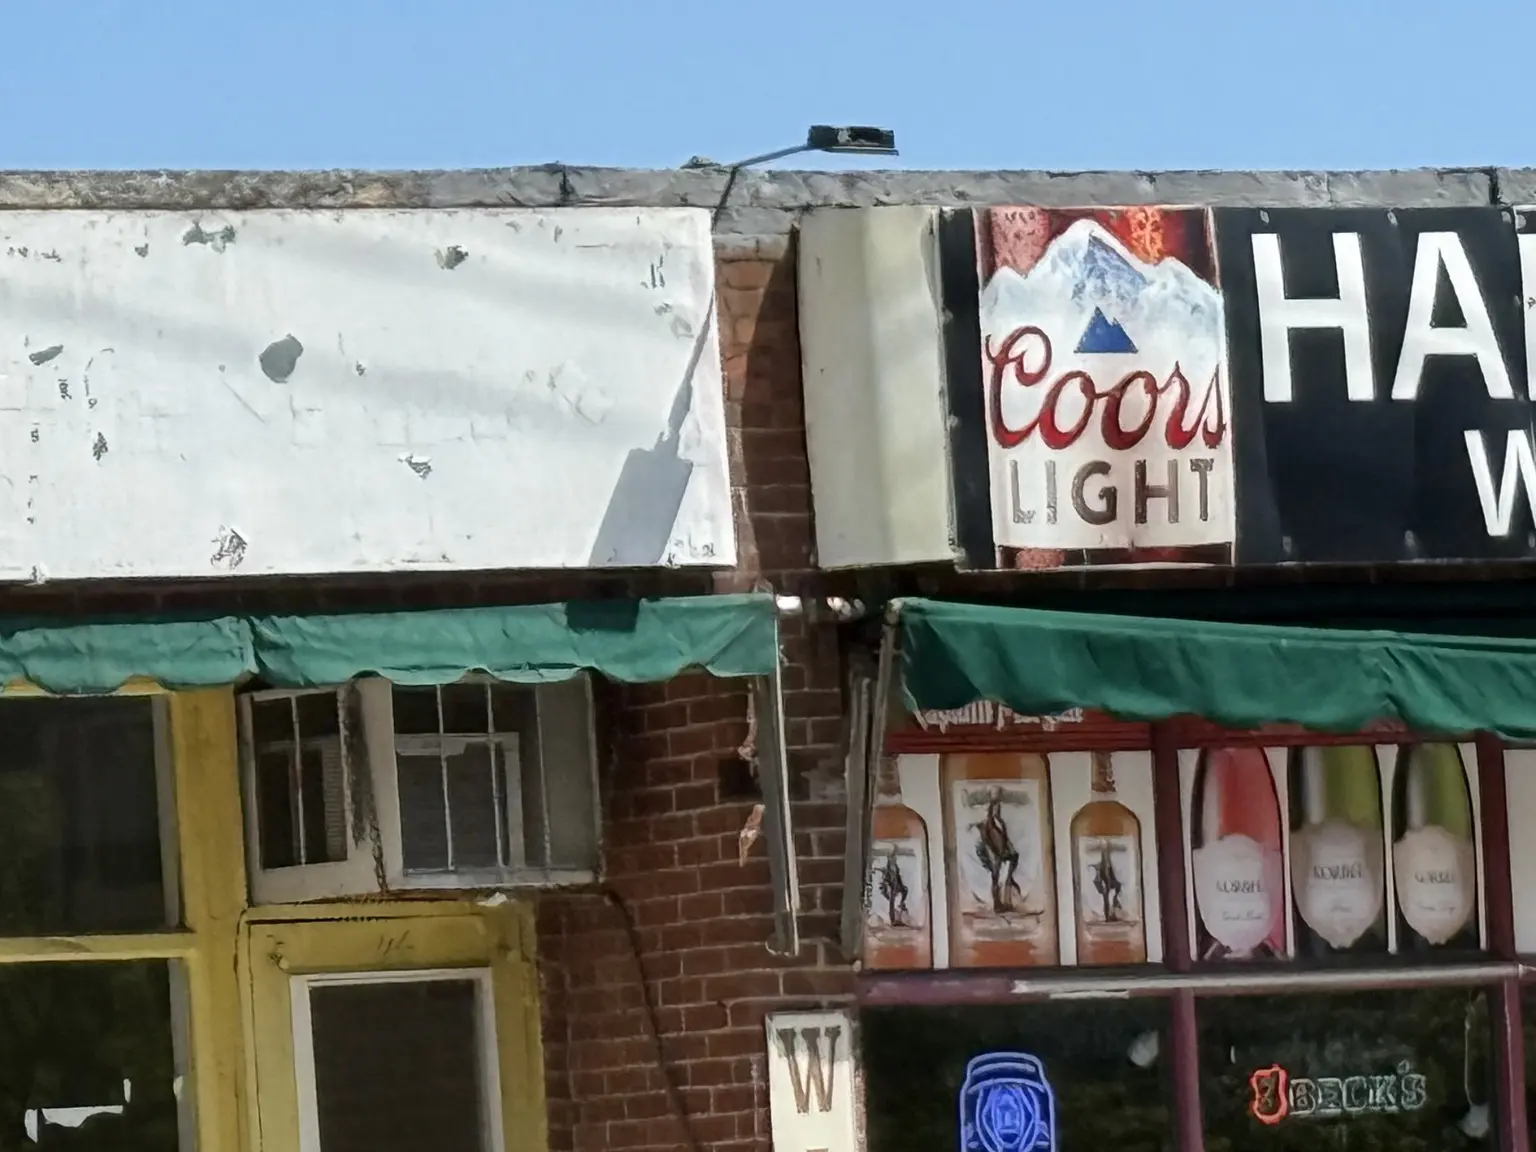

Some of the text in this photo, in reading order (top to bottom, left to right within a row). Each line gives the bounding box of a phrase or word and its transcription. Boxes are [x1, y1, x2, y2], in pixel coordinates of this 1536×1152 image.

[1251, 230, 1536, 402] HA
[985, 324, 1228, 450] Coors
[1009, 457, 1215, 526] LIGHT
